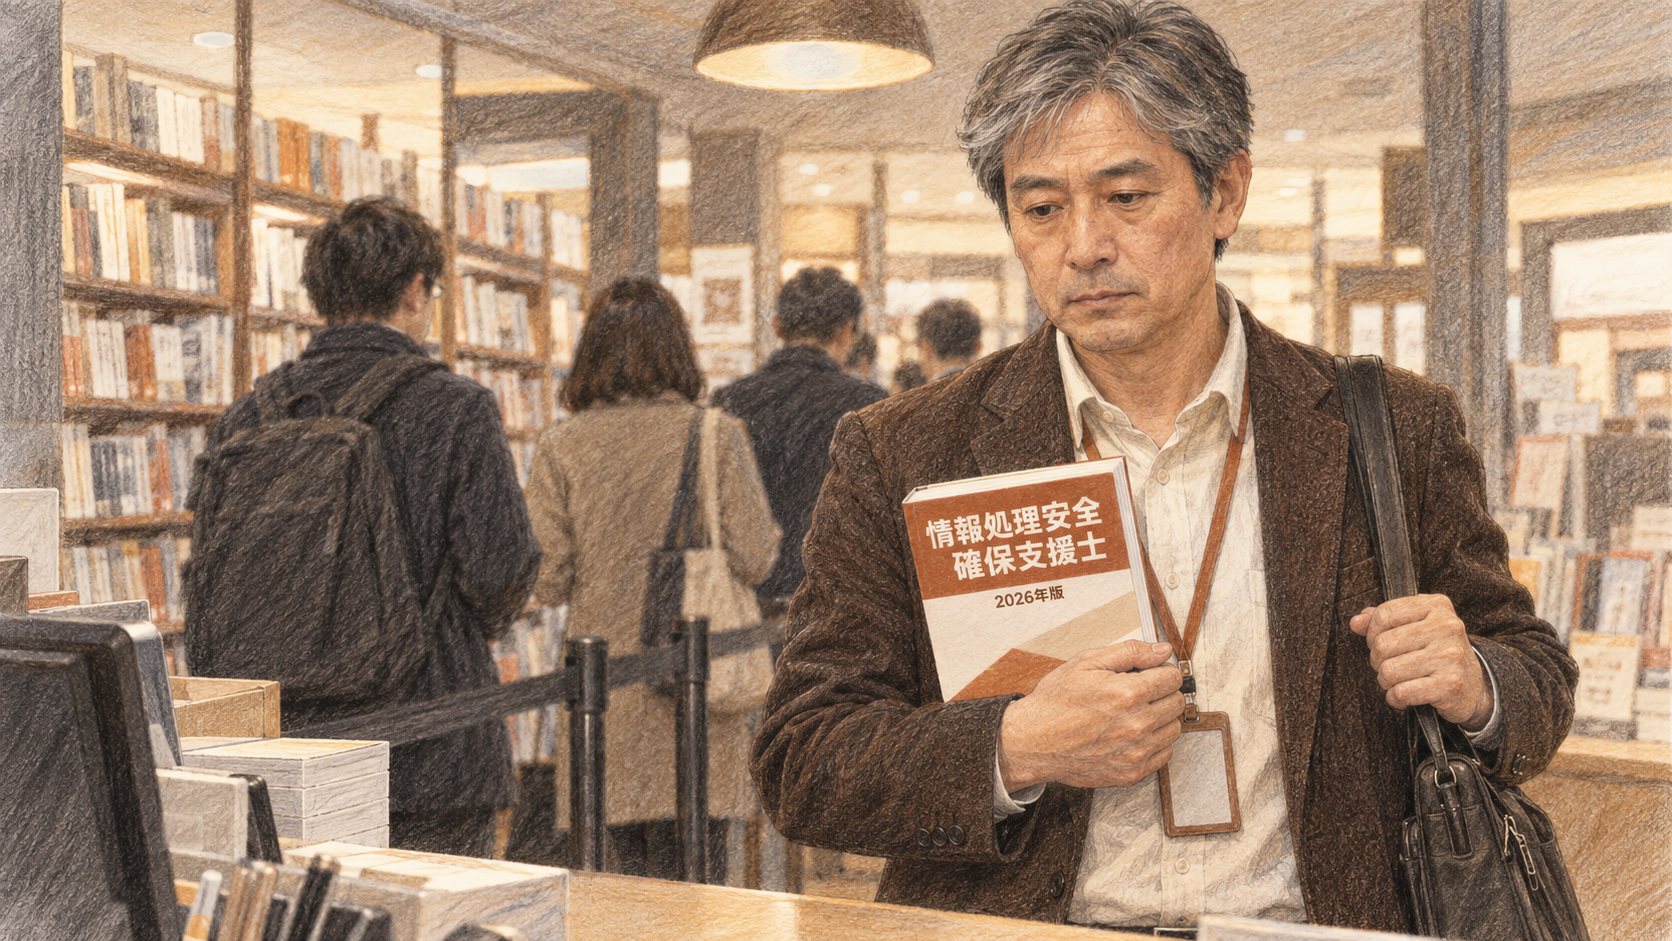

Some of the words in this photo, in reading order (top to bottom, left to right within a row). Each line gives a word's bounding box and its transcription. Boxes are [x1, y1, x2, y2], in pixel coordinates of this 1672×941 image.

[926, 496, 1102, 549] 情報処理安全
[952, 532, 1107, 581] 確保支援士
[995, 585, 1064, 608] 2026年版
